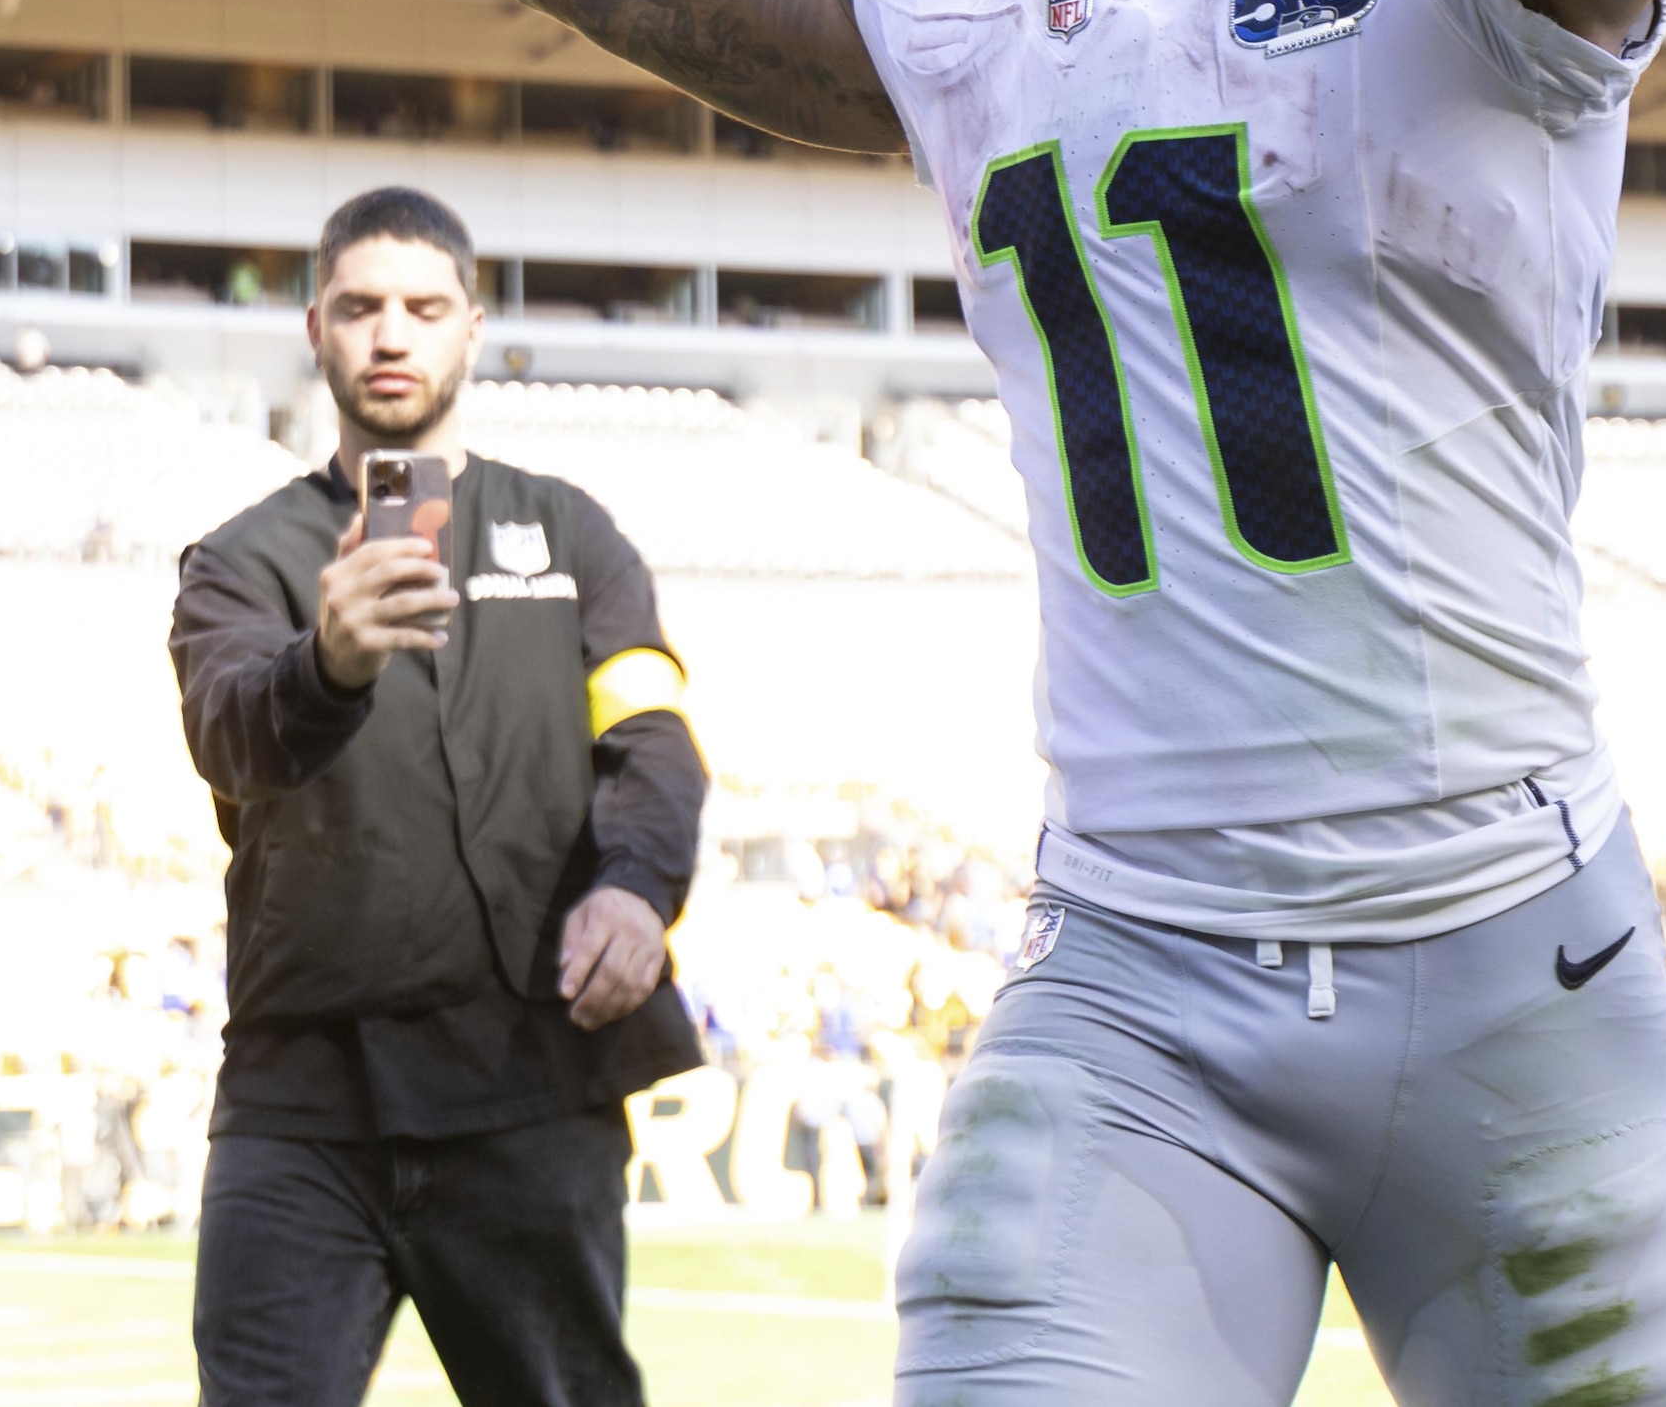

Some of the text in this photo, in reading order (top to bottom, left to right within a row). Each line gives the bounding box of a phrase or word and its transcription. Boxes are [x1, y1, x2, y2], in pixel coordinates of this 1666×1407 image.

[1051, 0, 1083, 28] NFL
[970, 122, 1353, 599] 11
[1063, 854, 1114, 882] DRI-FIT
[1023, 934, 1049, 959] NFL
